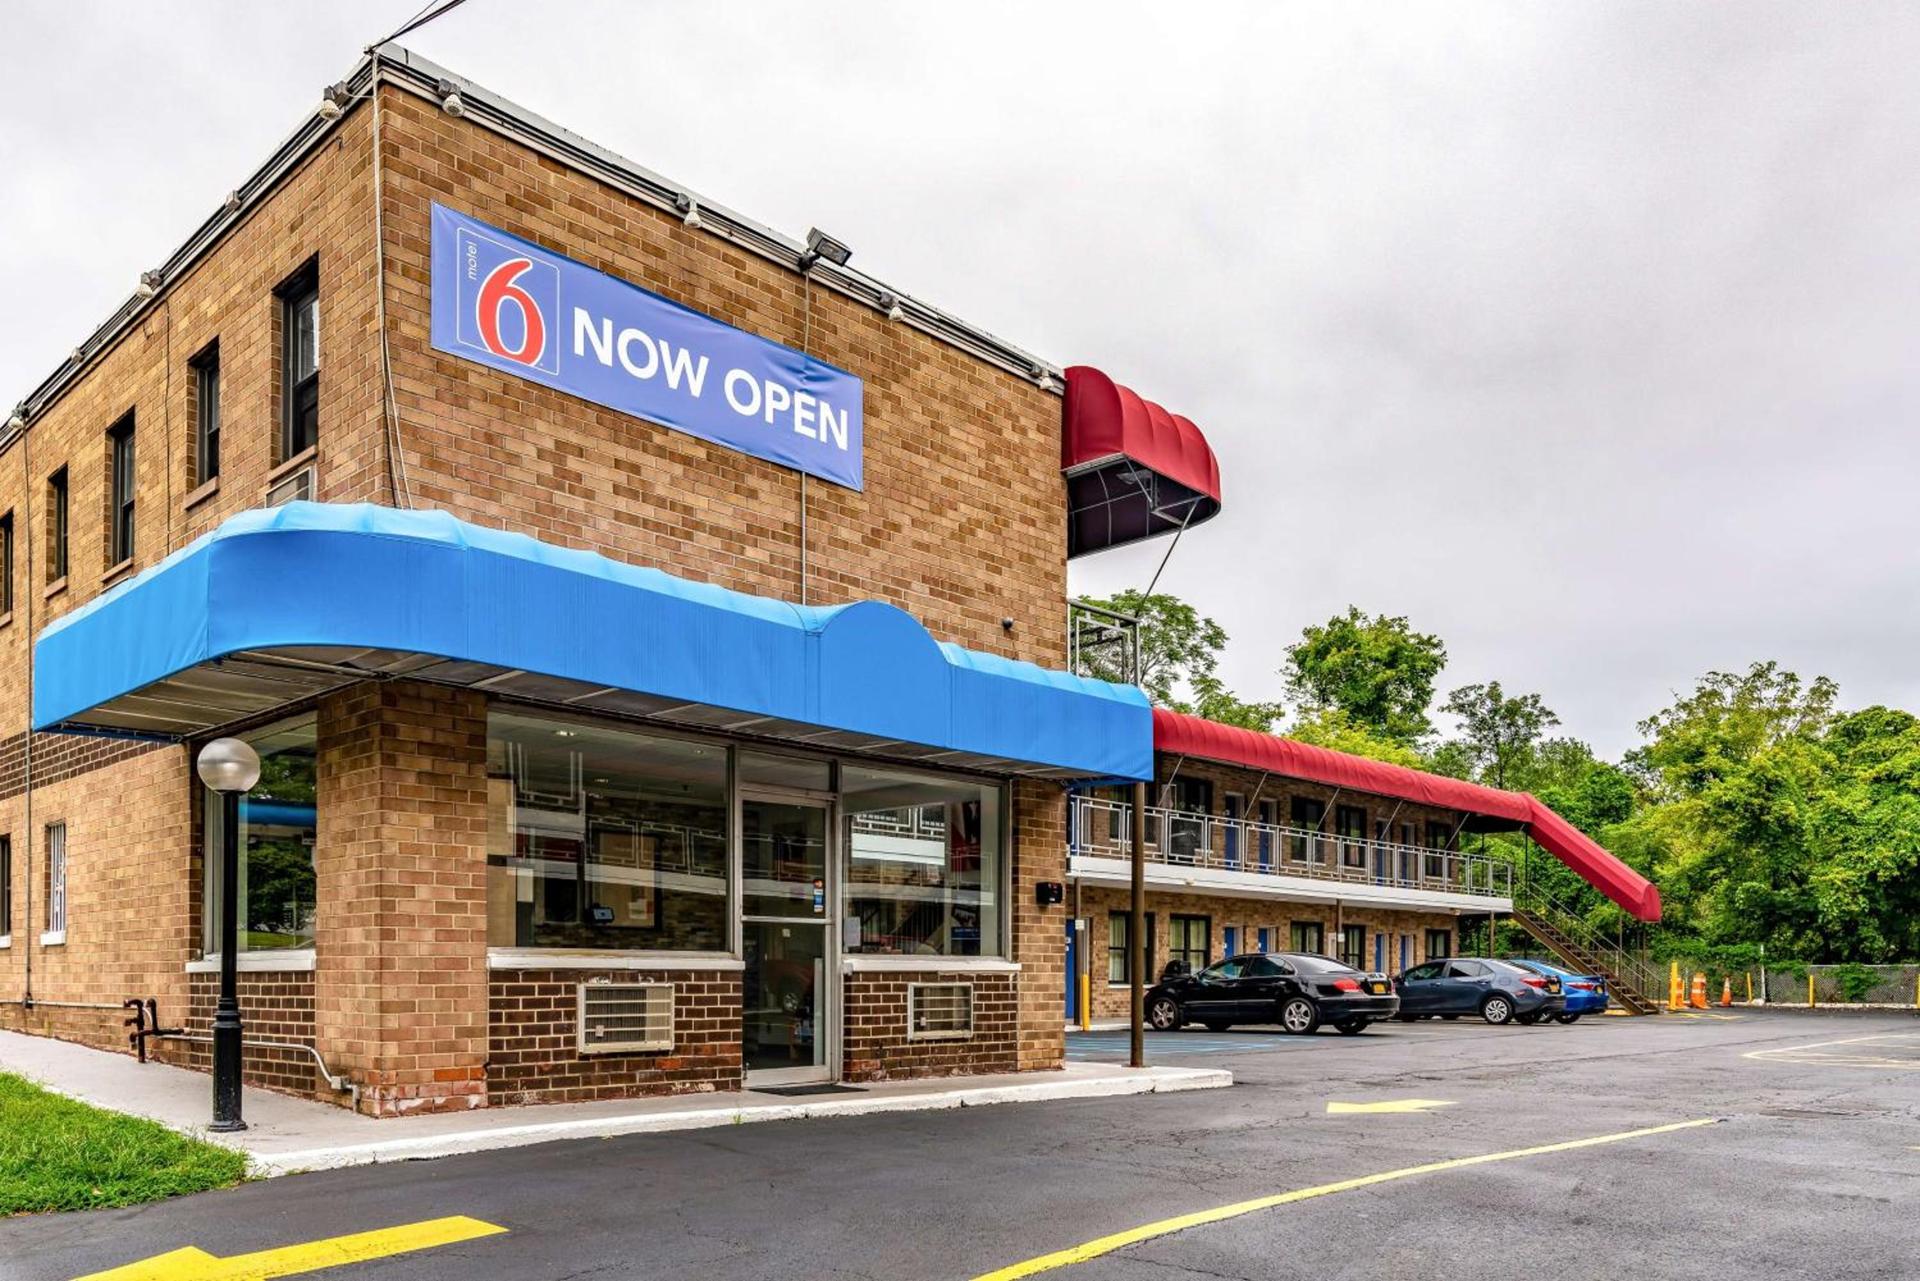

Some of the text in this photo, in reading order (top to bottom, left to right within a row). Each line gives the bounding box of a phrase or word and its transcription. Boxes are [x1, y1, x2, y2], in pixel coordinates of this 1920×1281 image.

[465, 240, 478, 281] motel
[475, 257, 547, 367] 6
[573, 306, 849, 451] NOW OPEN
